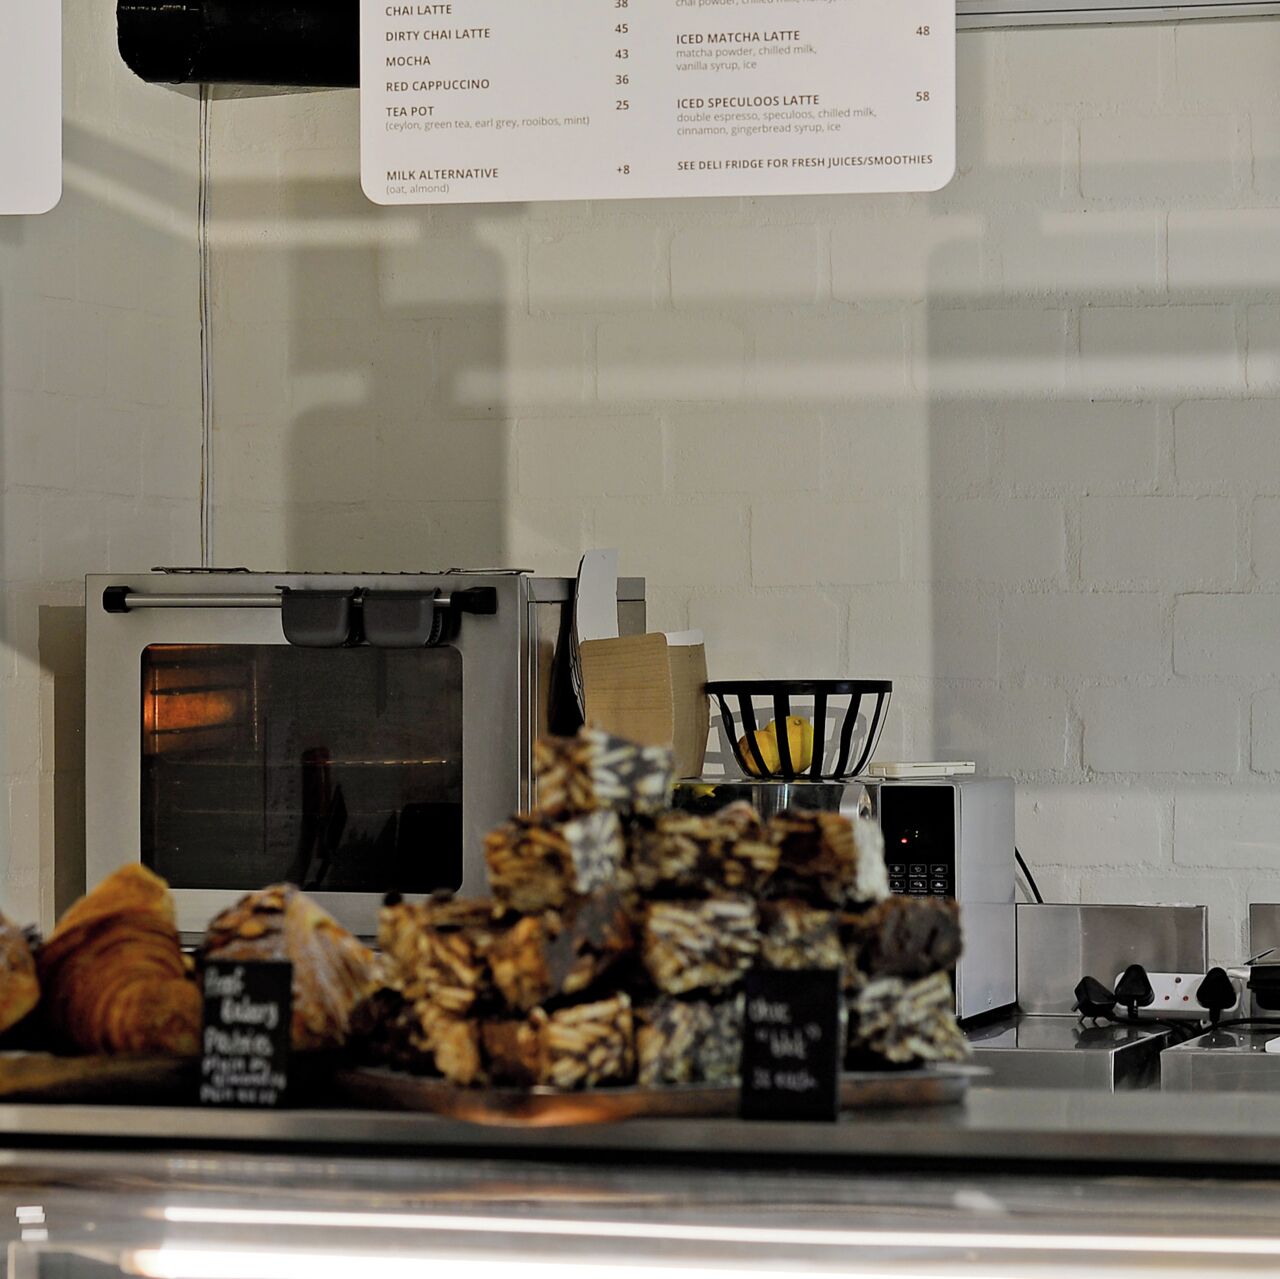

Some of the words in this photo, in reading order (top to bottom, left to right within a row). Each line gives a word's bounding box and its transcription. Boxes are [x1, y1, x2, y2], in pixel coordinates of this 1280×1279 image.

[385, 6, 413, 16] CHAI
[417, 4, 452, 16] LATTE
[614, 23, 628, 34] 45
[916, 25, 930, 36] 48
[386, 31, 420, 42] DIRTY
[423, 30, 452, 40] CHAI
[455, 28, 490, 39] LATTE
[676, 34, 704, 44] ICED
[707, 32, 760, 43] MATCHA
[764, 30, 800, 42] LATTE
[615, 48, 629, 59] 43
[676, 48, 713, 58] matcha
[715, 47, 756, 58] powder,
[758, 45, 791, 56] chilled
[793, 44, 817, 54] milk,
[386, 56, 431, 67] MOCHA
[386, 81, 409, 92] RED
[412, 78, 490, 91] CAPPUCCINO
[616, 74, 629, 85] 36
[677, 98, 704, 109] ICED
[708, 96, 780, 108] SPECULOOS
[783, 94, 819, 106] LATTE
[916, 91, 930, 102] 58
[616, 100, 630, 110] 25
[386, 107, 408, 117] TEA
[411, 106, 434, 116] POT
[677, 161, 695, 171] SEE
[698, 160, 722, 170] DELI
[725, 159, 764, 169] FRIDGE
[767, 158, 788, 168] FOR
[792, 158, 825, 167] FRESH
[827, 154, 933, 169] JUICES/SMOOTHIES
[386, 170, 416, 181] MILK
[419, 168, 498, 180] ALTERNATIVE
[617, 164, 630, 175] +8
[386, 185, 408, 196] (oat,
[410, 184, 450, 194] almond)
